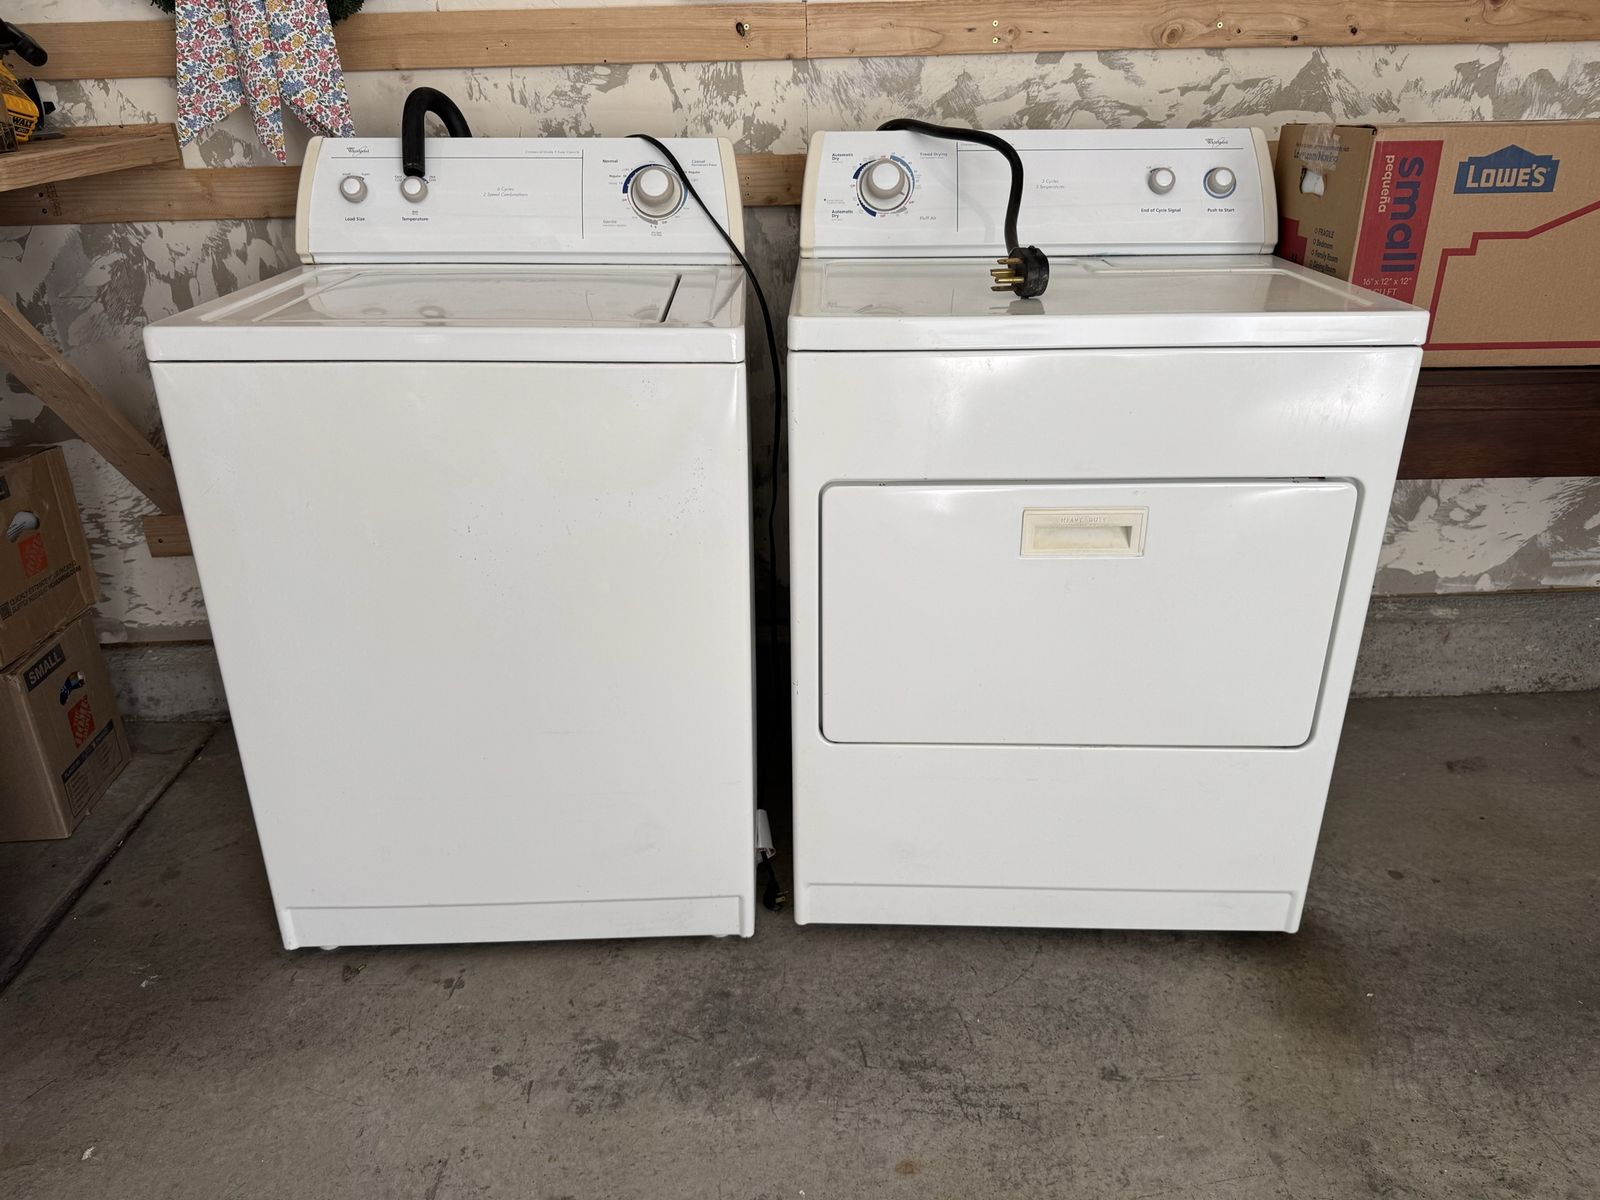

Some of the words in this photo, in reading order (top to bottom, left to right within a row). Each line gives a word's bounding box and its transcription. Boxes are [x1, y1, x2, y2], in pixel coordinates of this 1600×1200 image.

[1377, 154, 1396, 213] pequeña
[1466, 163, 1547, 188] LOWE'S
[1380, 156, 1425, 273] small
[1318, 227, 1335, 239] FRAGILE
[28, 651, 62, 686] SMALL
